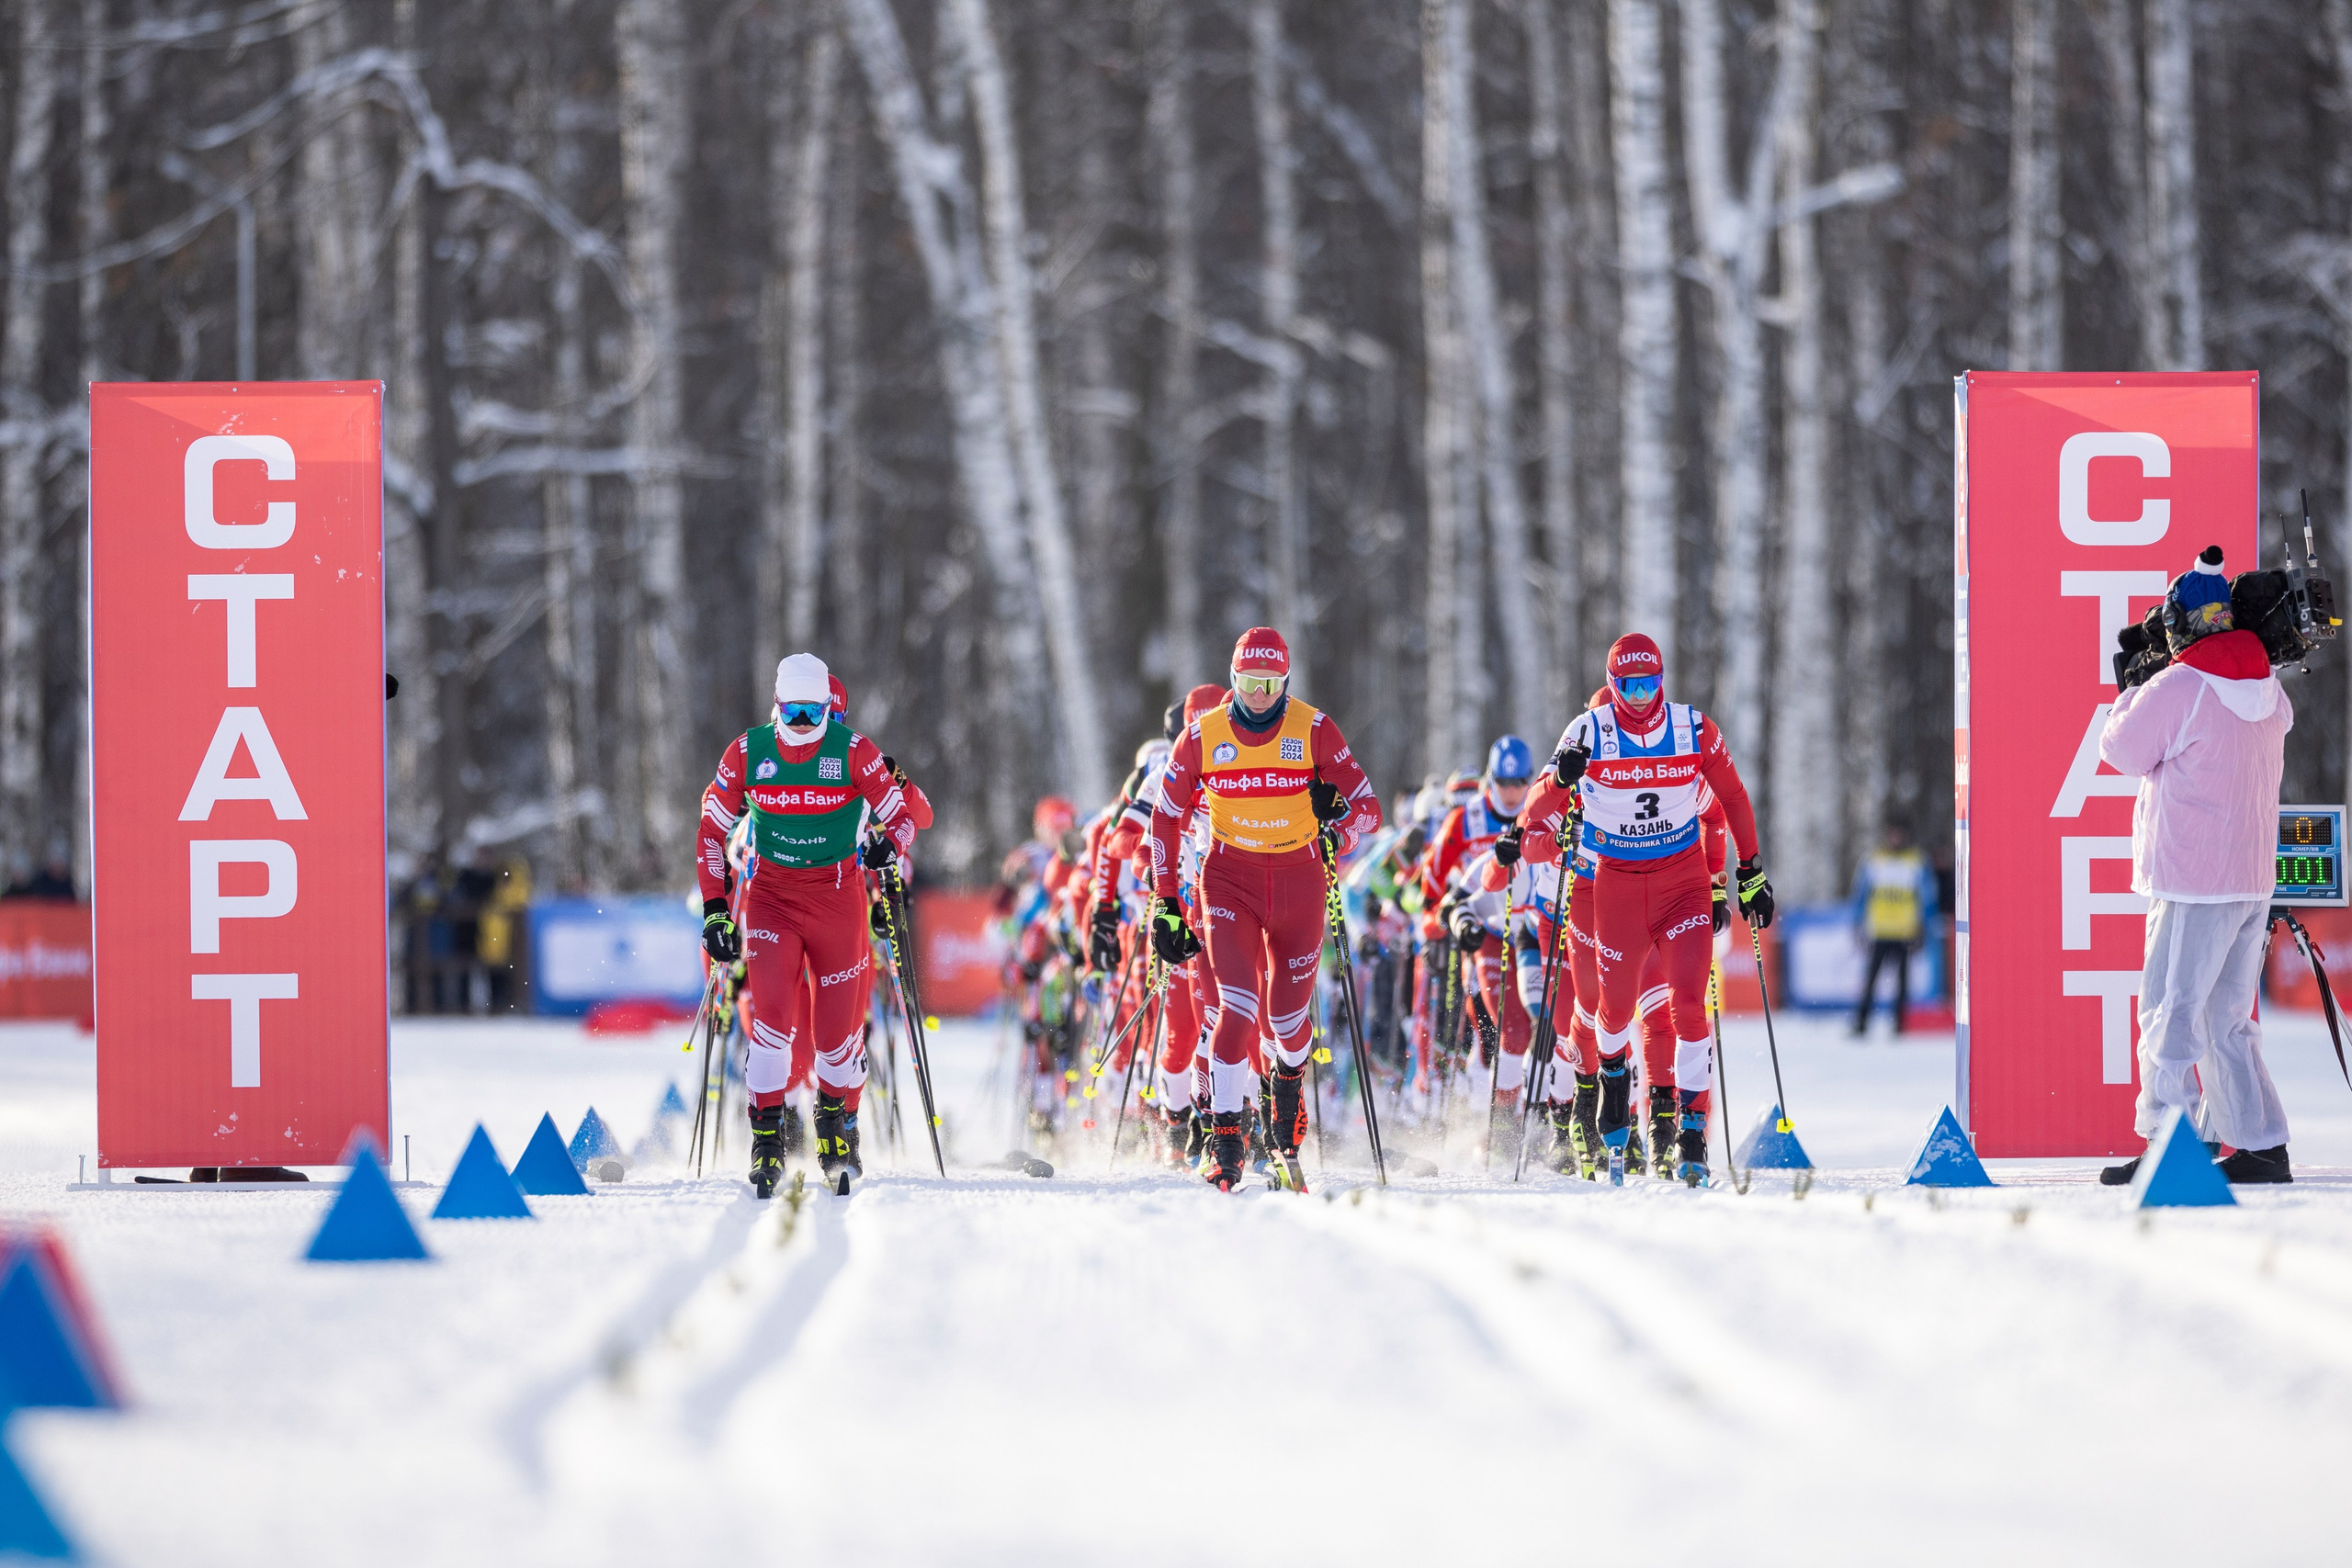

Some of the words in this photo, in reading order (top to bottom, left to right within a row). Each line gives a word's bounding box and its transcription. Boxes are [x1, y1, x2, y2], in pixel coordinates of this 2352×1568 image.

[1240, 648, 1284, 662] LUKOIL
[1616, 651, 1658, 666] LUKOIL
[1281, 744, 1303, 752] 2023
[177, 434, 309, 1088] СТАРТ
[1281, 752, 1303, 761] 2024
[819, 771, 841, 779] 2024
[820, 763, 841, 772] 2023
[1600, 765, 1654, 783] Альфа
[1657, 764, 1696, 779] Банк
[1207, 774, 1262, 791] Альфа
[1266, 773, 1309, 787] Банк
[750, 789, 800, 807] Альфа
[804, 791, 846, 806] Банк
[1634, 793, 1660, 820] 3
[1232, 815, 1289, 829] КАЗАНЬ
[1620, 819, 1673, 837] КАЗАНЬ
[2296, 817, 2312, 843] 0
[1610, 838, 1661, 848] РЕСПУБЛИКА
[1666, 913, 1711, 941] BOSCO
